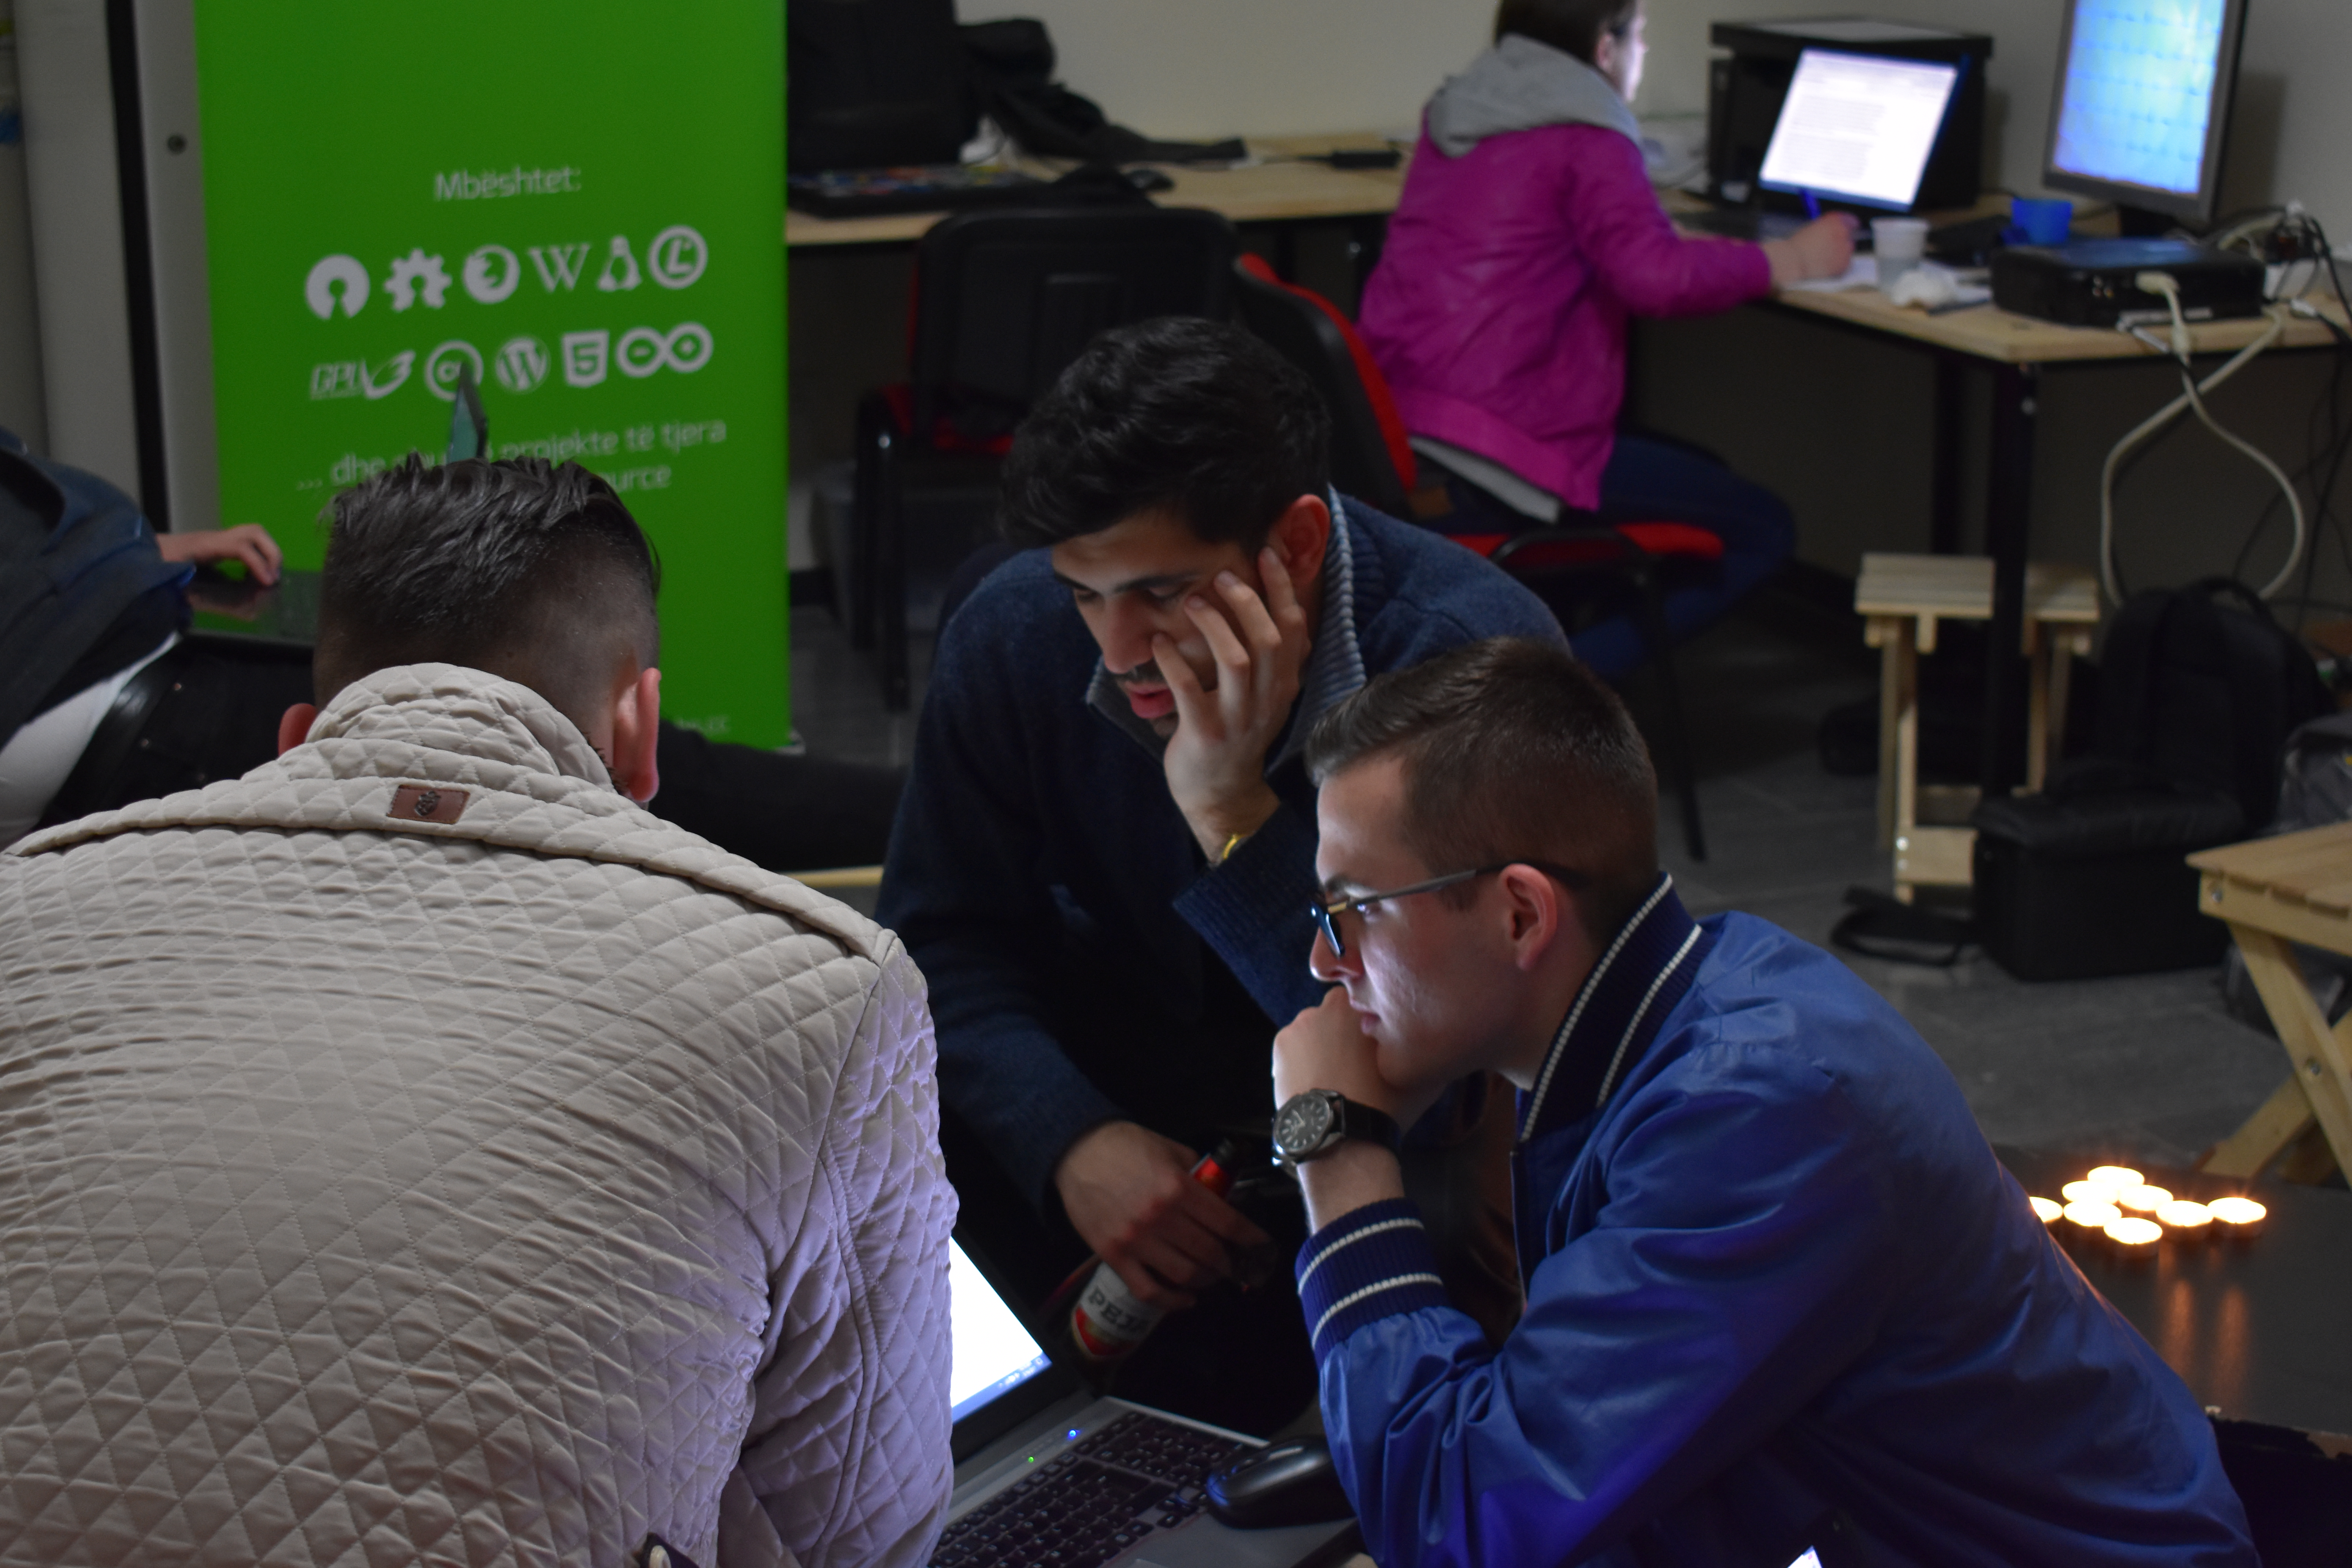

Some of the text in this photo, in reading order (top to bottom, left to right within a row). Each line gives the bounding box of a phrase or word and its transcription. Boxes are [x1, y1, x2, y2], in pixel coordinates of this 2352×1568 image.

[434, 165, 581, 201] Mbështet:
[624, 421, 655, 452] të
[661, 419, 726, 457] tjera
